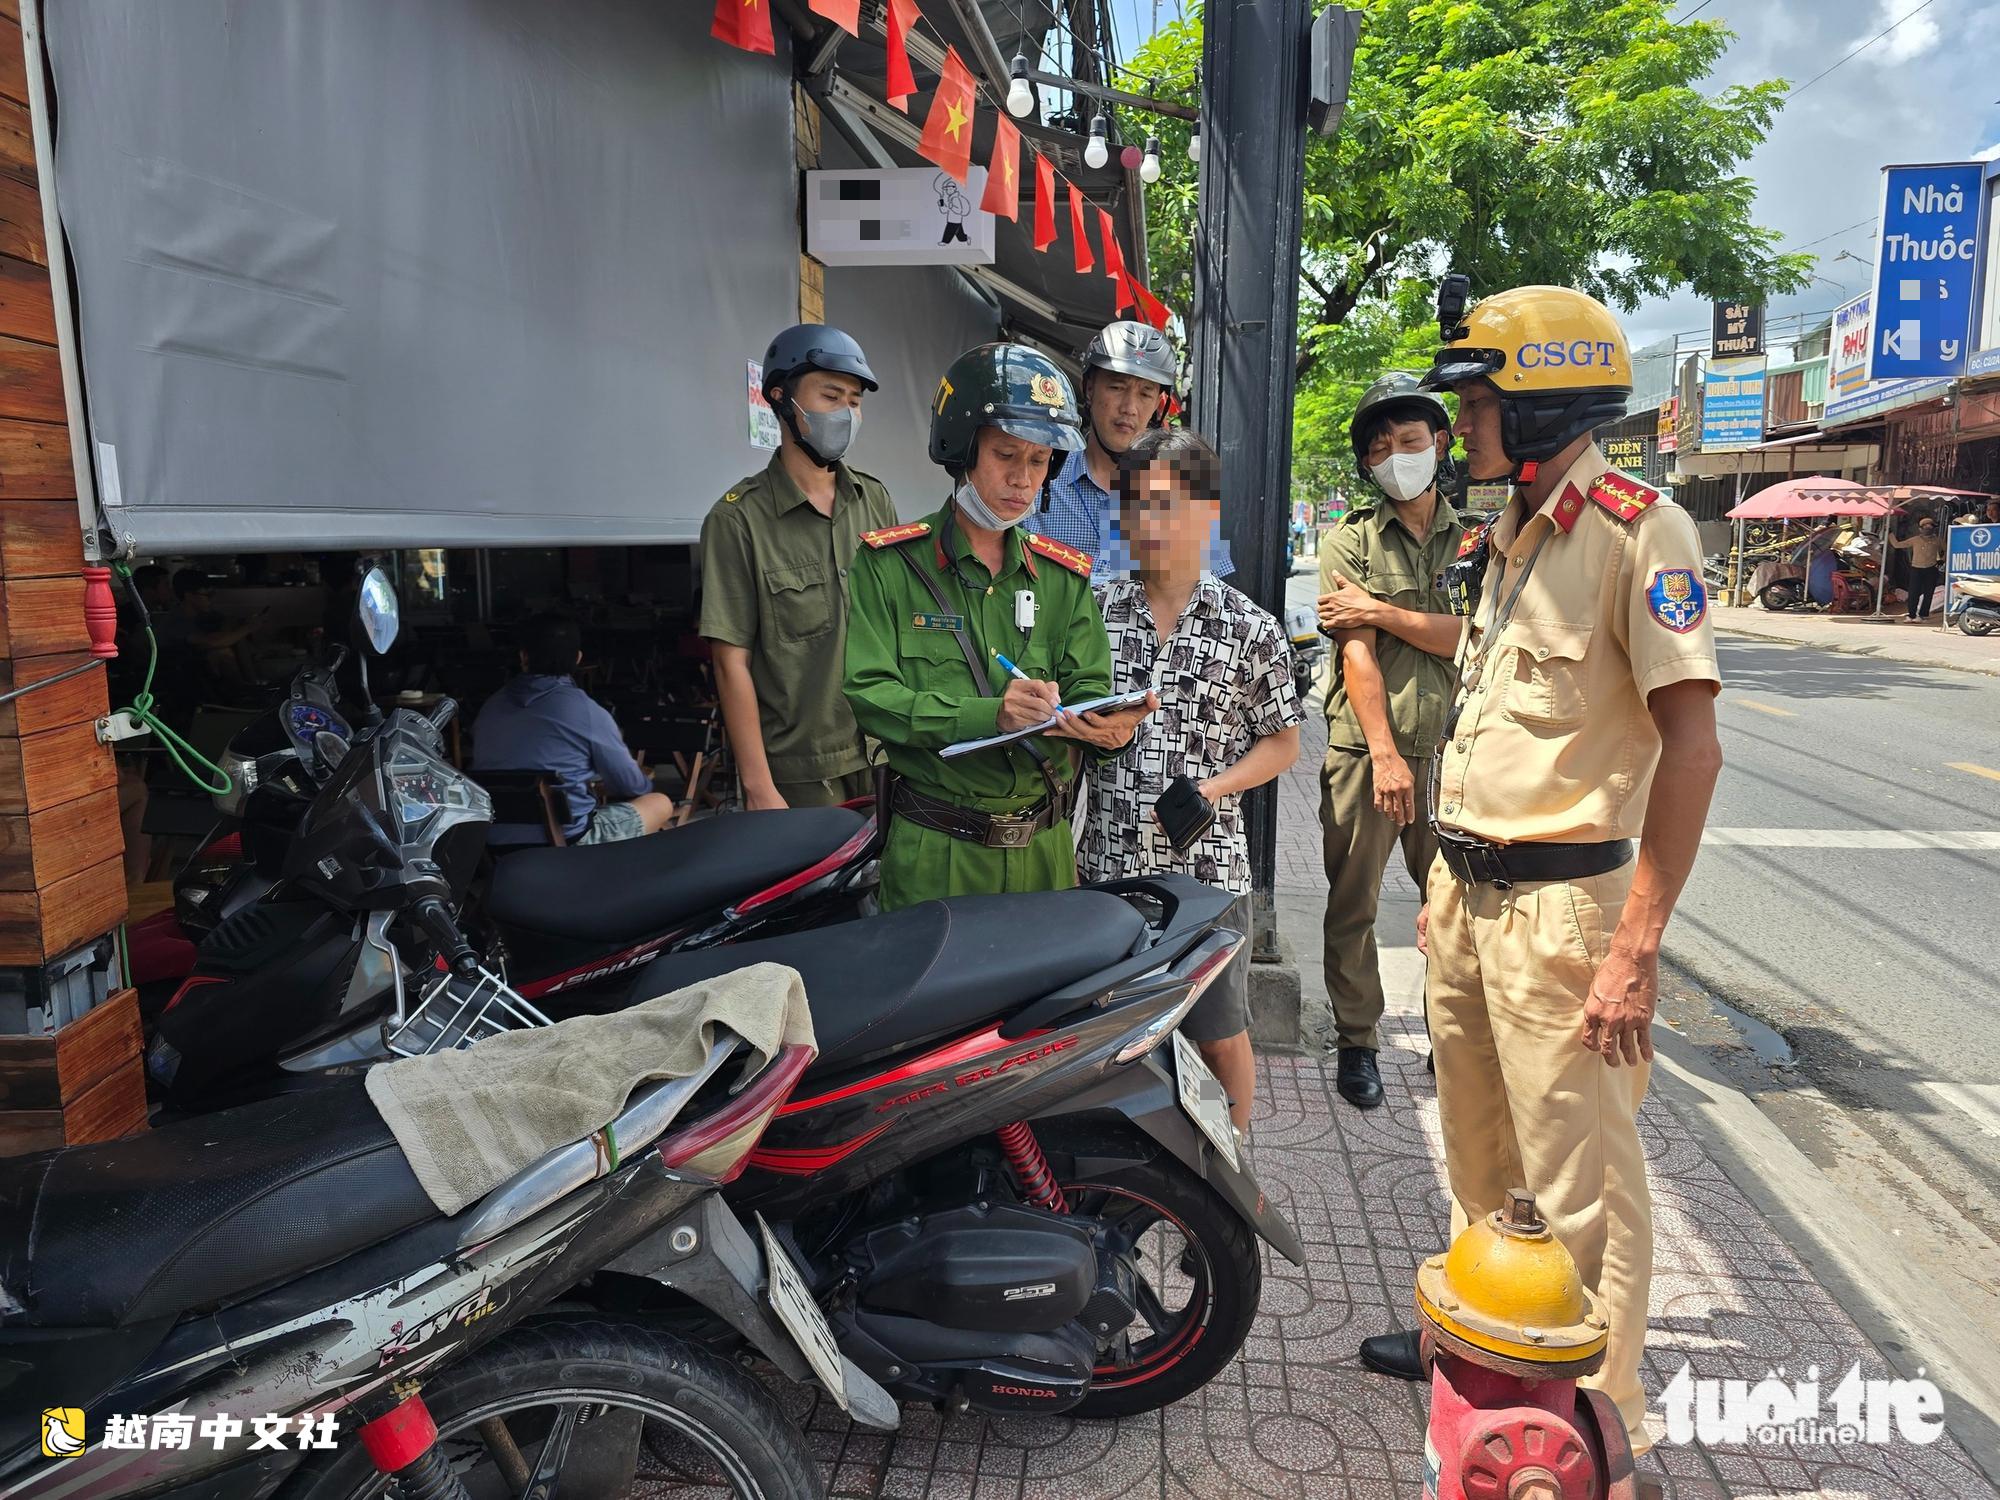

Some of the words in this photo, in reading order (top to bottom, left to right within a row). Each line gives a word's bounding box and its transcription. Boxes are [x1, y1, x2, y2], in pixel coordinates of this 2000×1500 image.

[1903, 183, 1963, 215] Nhà
[1886, 224, 1975, 262] Thuốc
[1717, 336, 1756, 352] THUẬT
[1516, 340, 1615, 369] CSGT
[1608, 440, 1642, 457] ĐIỆN
[1952, 549, 1973, 571] NHÀ
[1660, 602, 1676, 612] CS
[991, 1385, 1058, 1399] HONDA
